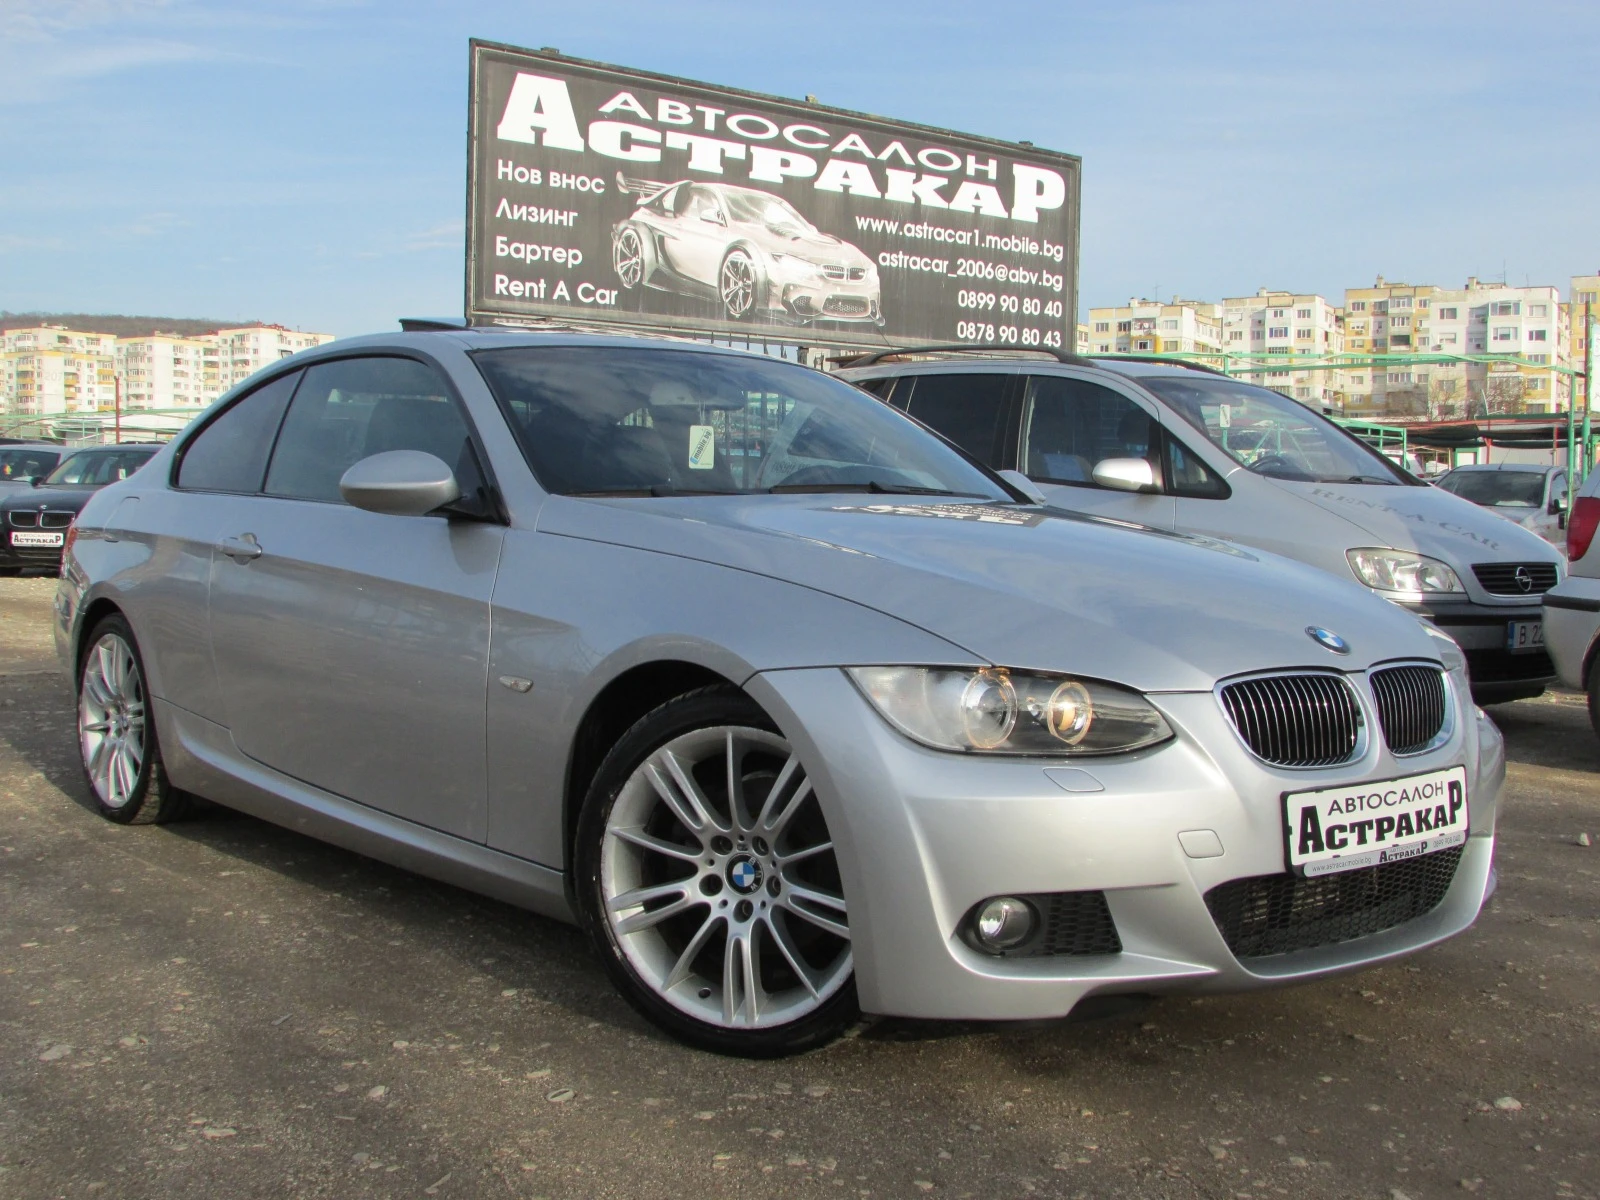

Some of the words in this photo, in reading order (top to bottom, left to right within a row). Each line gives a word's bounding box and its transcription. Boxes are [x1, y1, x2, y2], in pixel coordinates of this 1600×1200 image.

[598, 91, 997, 180] АВТОСАЛОН
[497, 158, 542, 185] Нов
[549, 171, 606, 194] внос
[495, 197, 579, 227] Лизинг
[495, 235, 583, 268] Бартер
[855, 215, 1064, 262] www.astracar1.mobile.bg
[878, 251, 1063, 292] astracar_2006@abv.bg
[495, 274, 547, 299] Rent
[552, 280, 571, 301] A
[577, 282, 619, 305] Car
[957, 290, 996, 311] 0899
[999, 294, 1019, 313] 90
[1022, 298, 1041, 316] 80
[1044, 300, 1063, 318] 40
[956, 320, 995, 341] 0878
[999, 325, 1018, 344] 90
[1021, 328, 1040, 346] 80
[1043, 330, 1062, 348] 43
[1327, 780, 1444, 816] АВТОСАЛОН
